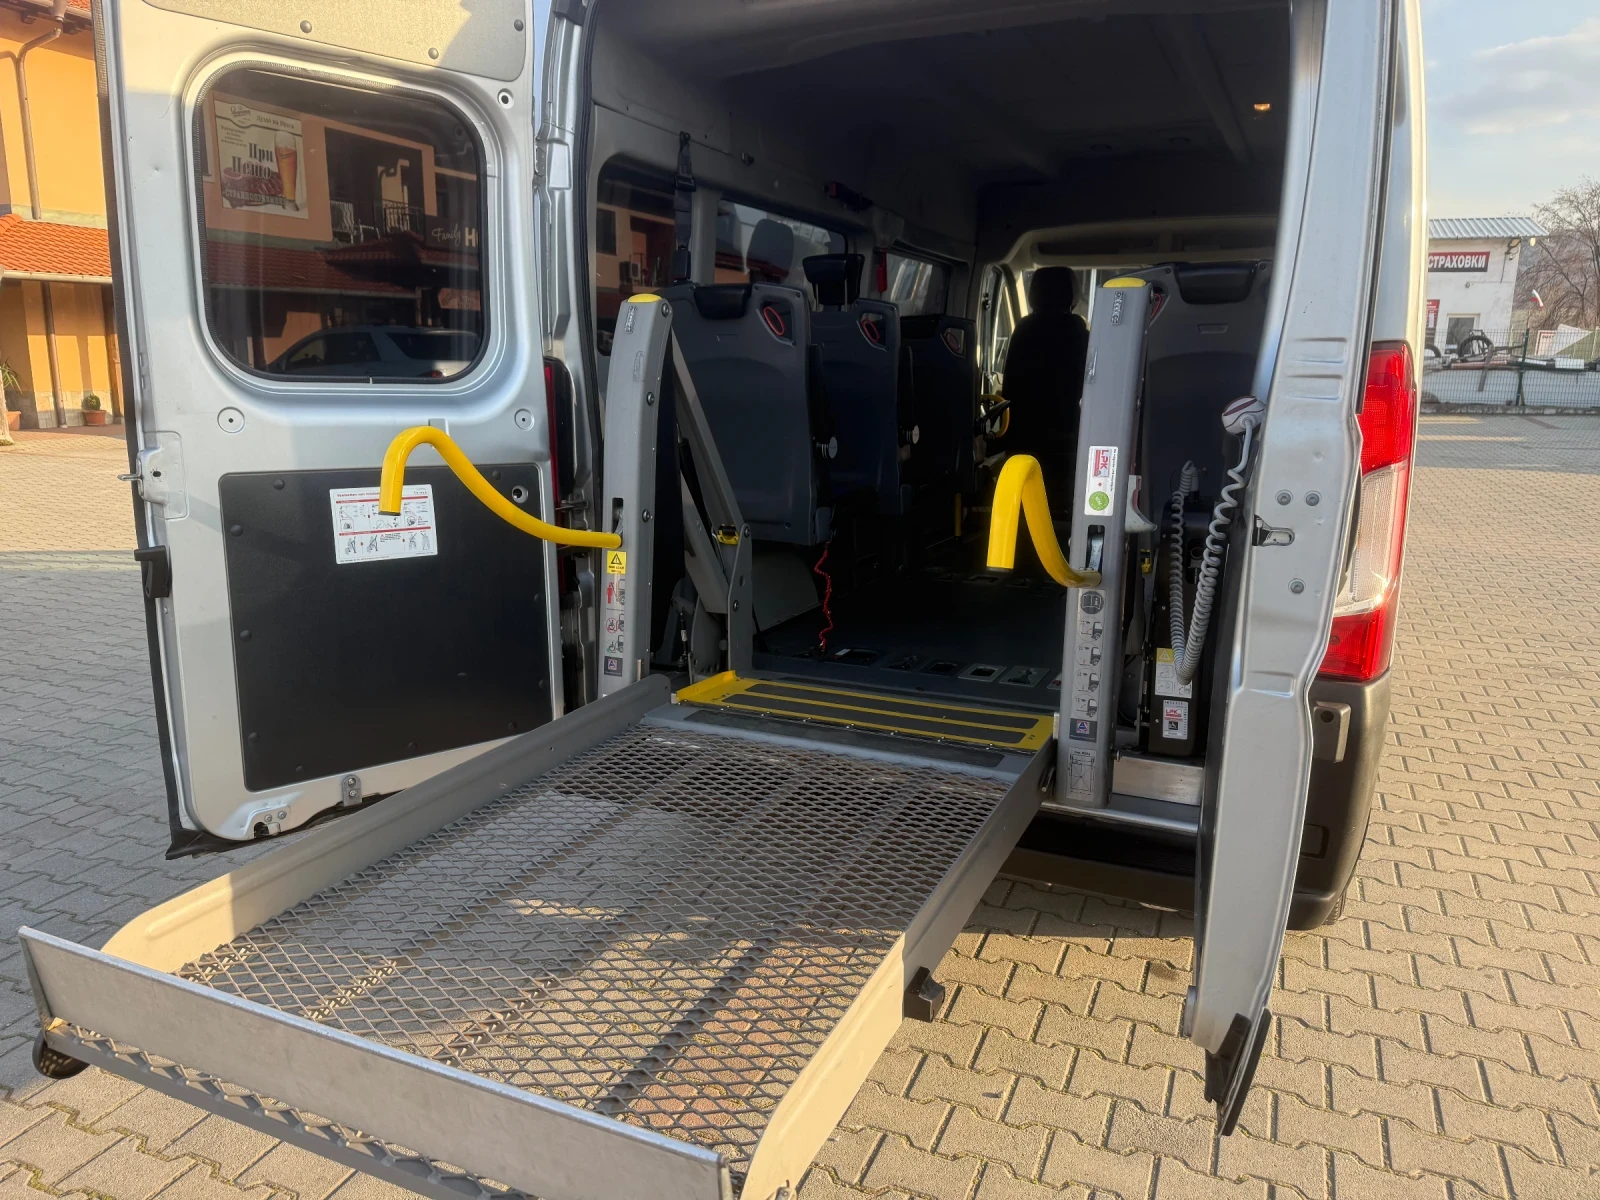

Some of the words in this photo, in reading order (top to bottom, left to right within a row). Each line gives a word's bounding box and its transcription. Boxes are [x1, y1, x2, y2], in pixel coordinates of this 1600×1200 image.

[248, 142, 274, 163] При
[232, 155, 272, 179] Пешо
[431, 223, 462, 246] Family
[465, 227, 479, 248] H
[1428, 254, 1486, 268] СТРАХОВКИ
[1101, 449, 1109, 470] LPK
